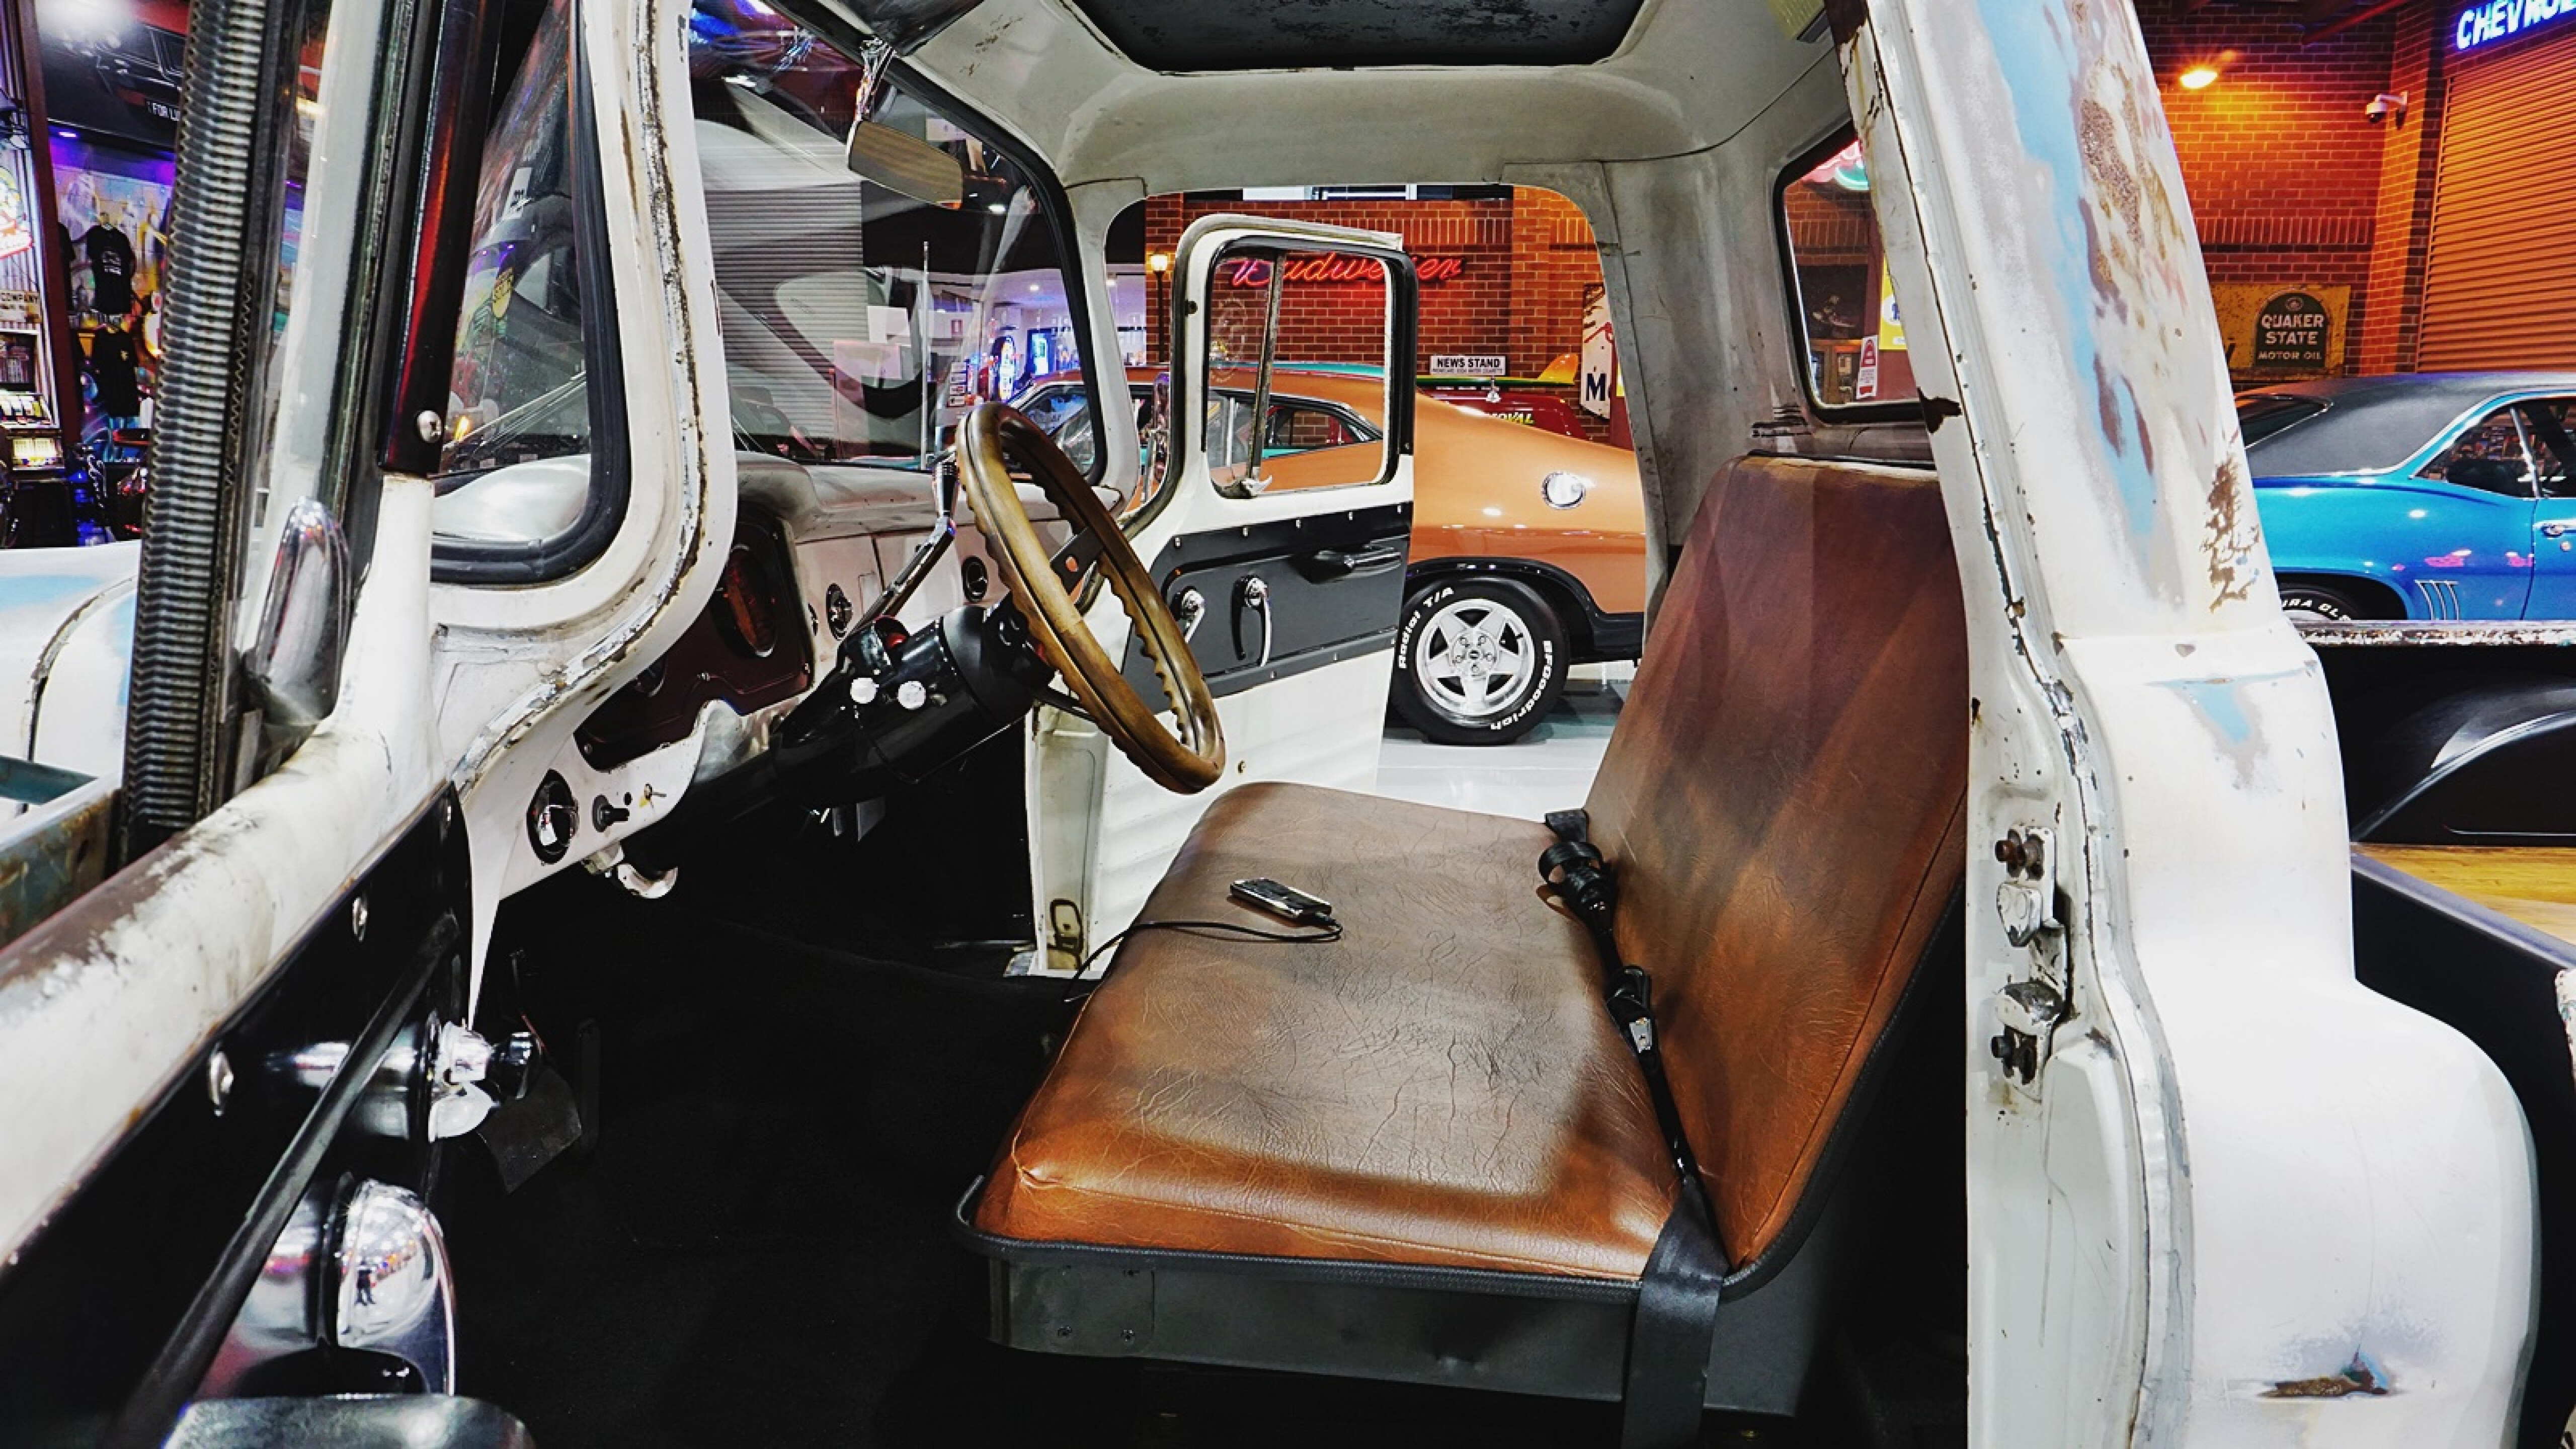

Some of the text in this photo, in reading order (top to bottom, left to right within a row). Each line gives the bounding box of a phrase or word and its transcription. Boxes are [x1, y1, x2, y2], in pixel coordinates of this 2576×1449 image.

[2261, 314, 2324, 329] QUAKER
[2265, 331, 2319, 345] STATE
[1437, 357, 1501, 368] NEWS STAND
[2257, 351, 2322, 360] MOTOR OIL
[1398, 610, 1421, 669] Radial
